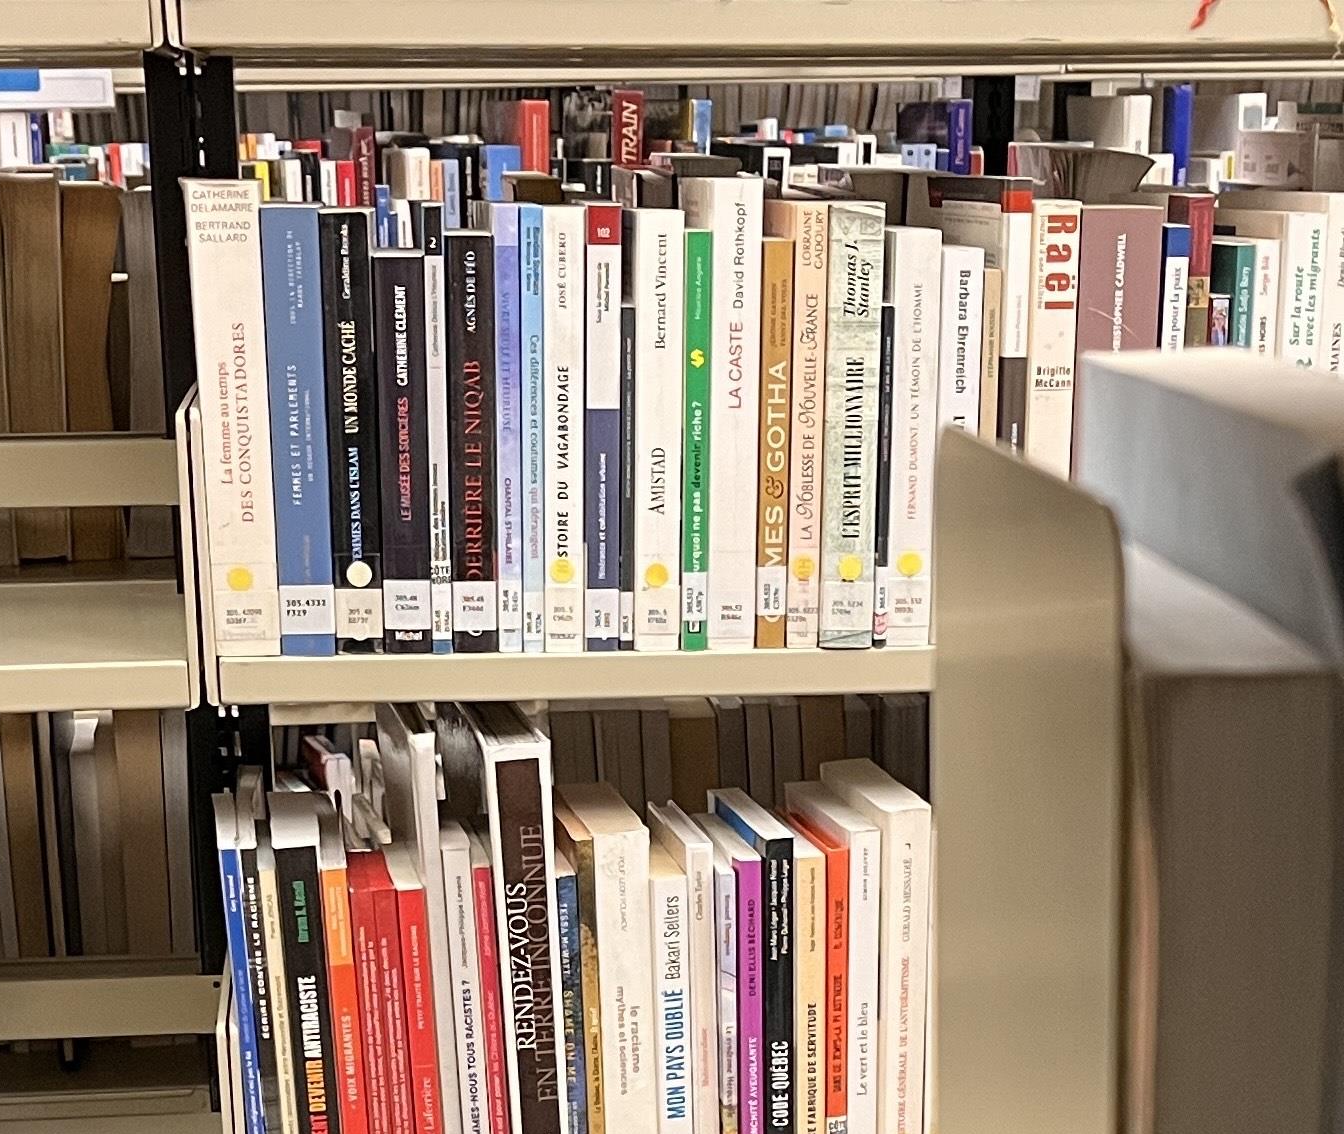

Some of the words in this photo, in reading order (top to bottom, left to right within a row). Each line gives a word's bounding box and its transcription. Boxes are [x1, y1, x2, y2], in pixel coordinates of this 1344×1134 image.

[195, 220, 252, 232] BERTRAND
[198, 232, 248, 243] SALLARD
[731, 202, 747, 267] Rothkopf
[802, 210, 813, 267] LORRAINE
[654, 233, 668, 291] Vincent
[1043, 214, 1078, 310] Raël
[1115, 234, 1127, 288] CALDWELL
[1171, 267, 1182, 291] paix
[1308, 228, 1322, 291] migrants
[731, 270, 745, 310] David
[842, 255, 857, 318] Thomas
[857, 258, 872, 318] Stanley
[957, 270, 971, 321] Barbara
[1169, 293, 1180, 303] la
[1293, 266, 1304, 302] route
[1304, 294, 1317, 313] les
[392, 285, 407, 331] CLÉMENT
[654, 293, 667, 349] Bernard
[1170, 305, 1182, 332] pour
[1290, 306, 1302, 319] la
[336, 320, 356, 365] CACHÉ
[728, 322, 744, 382] CASTE
[1289, 321, 1303, 346] Sur
[1304, 315, 1315, 346] avec
[394, 330, 409, 386] CATHERINE
[909, 357, 921, 401] TÉMOIN
[954, 325, 968, 394] Ehrenreich
[216, 361, 231, 401] temps
[285, 364, 300, 437] PARLEMENTS
[342, 366, 358, 413] MONDE
[462, 360, 483, 435] NIQAB
[529, 356, 540, 417] différences
[728, 386, 743, 410] LA
[220, 402, 231, 419] au
[232, 321, 253, 485] CONQUISTADORES
[344, 415, 359, 434] UN
[529, 419, 539, 430] et
[556, 365, 570, 469] VAGABONDAGE
[766, 360, 787, 472] GOTHA
[219, 421, 232, 465] femme
[288, 441, 301, 457] ET
[464, 443, 483, 468] LE
[529, 432, 539, 484] coutumes
[220, 467, 233, 485] La
[690, 442, 702, 488] devenir
[240, 489, 255, 524] DES
[349, 490, 362, 520] DANS
[396, 473, 411, 508] MUSÉE
[557, 481, 569, 500] DU
[692, 491, 704, 513] pas
[528, 506, 541, 560] dérangent
[692, 514, 702, 531] ne
[520, 824, 554, 973] INCONNUE
[664, 895, 680, 938] Sellers
[745, 899, 756, 944] BÉCHARD
[505, 881, 537, 1052] RENDEZ-VOUS
[665, 940, 681, 980] Bakari
[747, 944, 757, 972] ELLIS
[748, 974, 757, 997] DENI
[297, 975, 324, 1058] ANTIRACISTE
[461, 989, 476, 1040] RACISTES
[532, 974, 556, 1070] TERRE
[564, 990, 575, 1036] SHAME
[615, 986, 627, 1029] mythes
[630, 1006, 641, 1018] le
[660, 988, 684, 1041] OUBLIÉ
[858, 1002, 869, 1026] bleu
[565, 1042, 575, 1061] ON
[617, 1031, 627, 1042] et
[630, 1021, 642, 1073] racisme
[806, 1002, 817, 1058] SERVITUDE
[858, 1028, 868, 1041] le
[858, 1042, 868, 1055] et
[466, 1041, 477, 1070] TOUS
[566, 1066, 576, 1084] ME
[618, 1045, 629, 1095] sciences
[665, 1045, 685, 1081] PAYS
[748, 1036, 758, 1098] AVEUGLANTE
[769, 1040, 788, 1091] QUÉBEC
[807, 1060, 817, 1074] DE
[859, 1057, 868, 1080] vert
[305, 1059, 326, 1113] DEVENIR
[536, 1070, 558, 1103] EN
[666, 1084, 687, 1120] MON
[806, 1077, 817, 1125] FABRIQUE
[858, 1082, 868, 1096] Le
[772, 1092, 789, 1127] CODE
